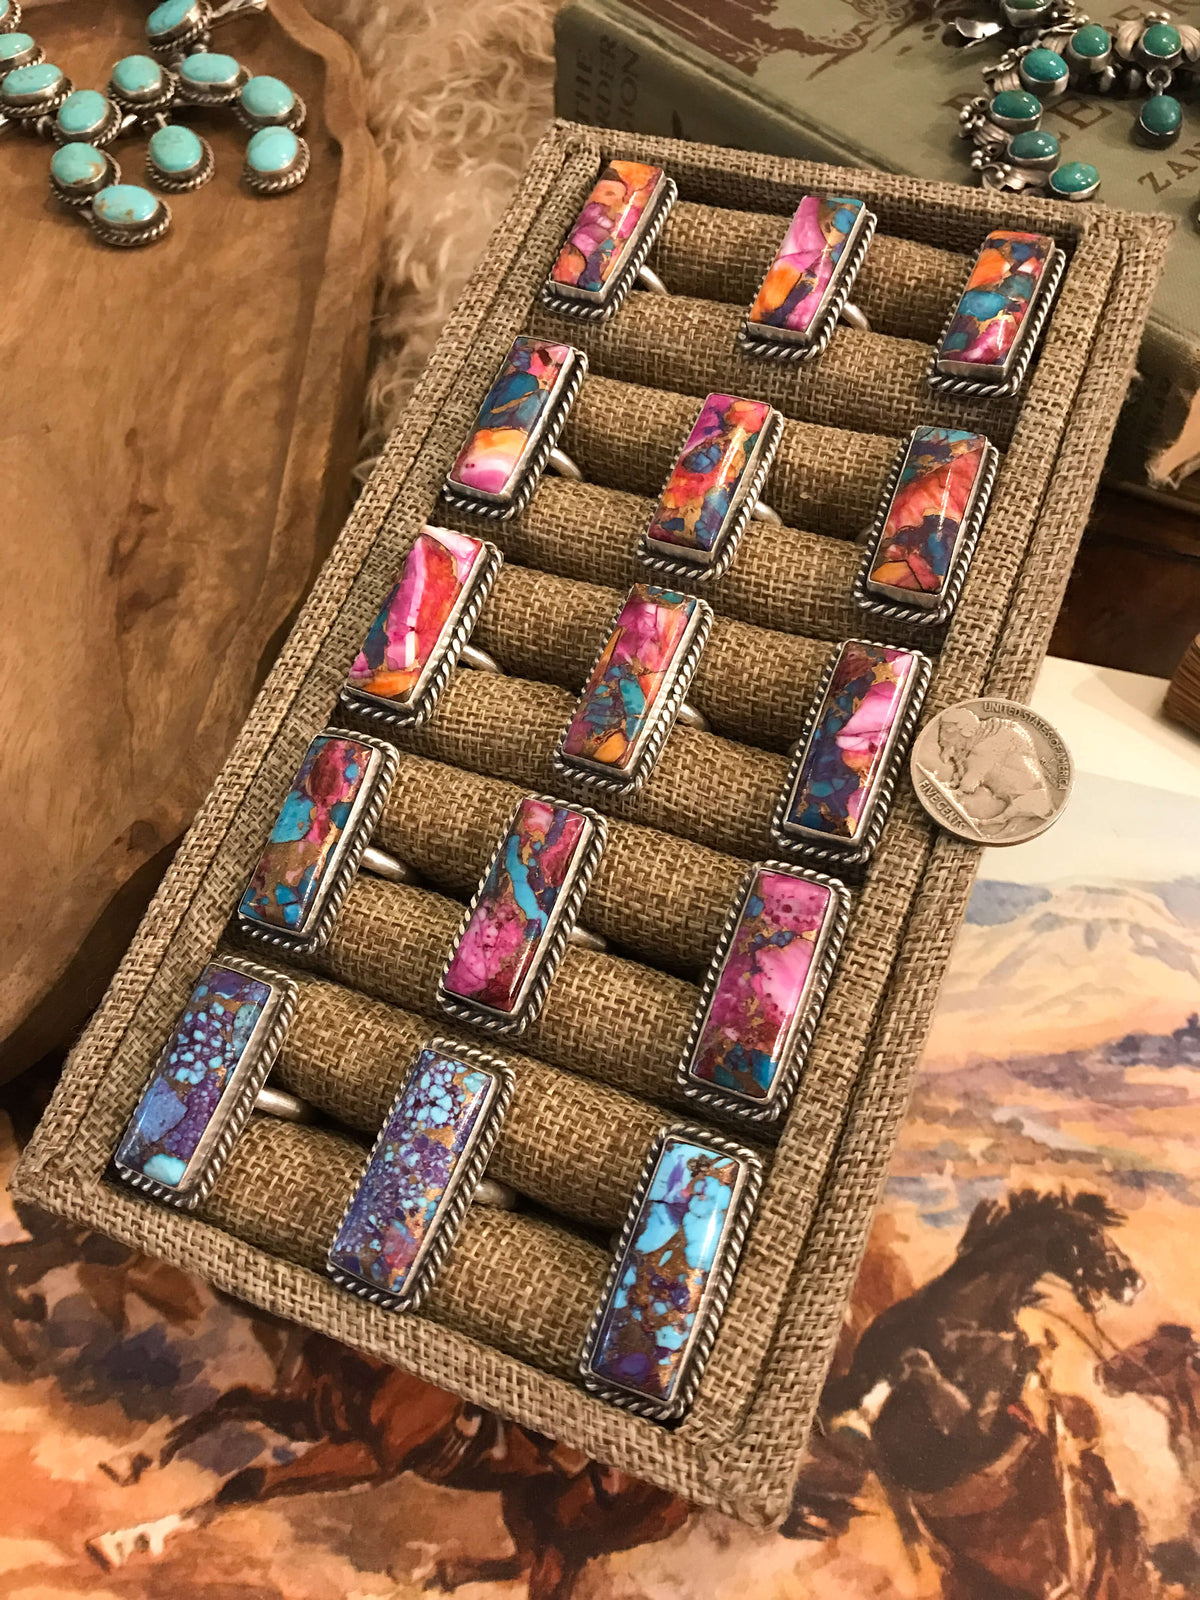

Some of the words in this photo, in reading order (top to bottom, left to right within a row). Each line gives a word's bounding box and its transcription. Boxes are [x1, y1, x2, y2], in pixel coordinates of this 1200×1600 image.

[983, 702, 1020, 717] UNITED
[1022, 711, 1054, 740] STATES
[1049, 738, 1066, 753] OF
[1056, 751, 1071, 791] AMERICA
[919, 779, 940, 804] FIVE
[936, 800, 966, 830] CENTS
